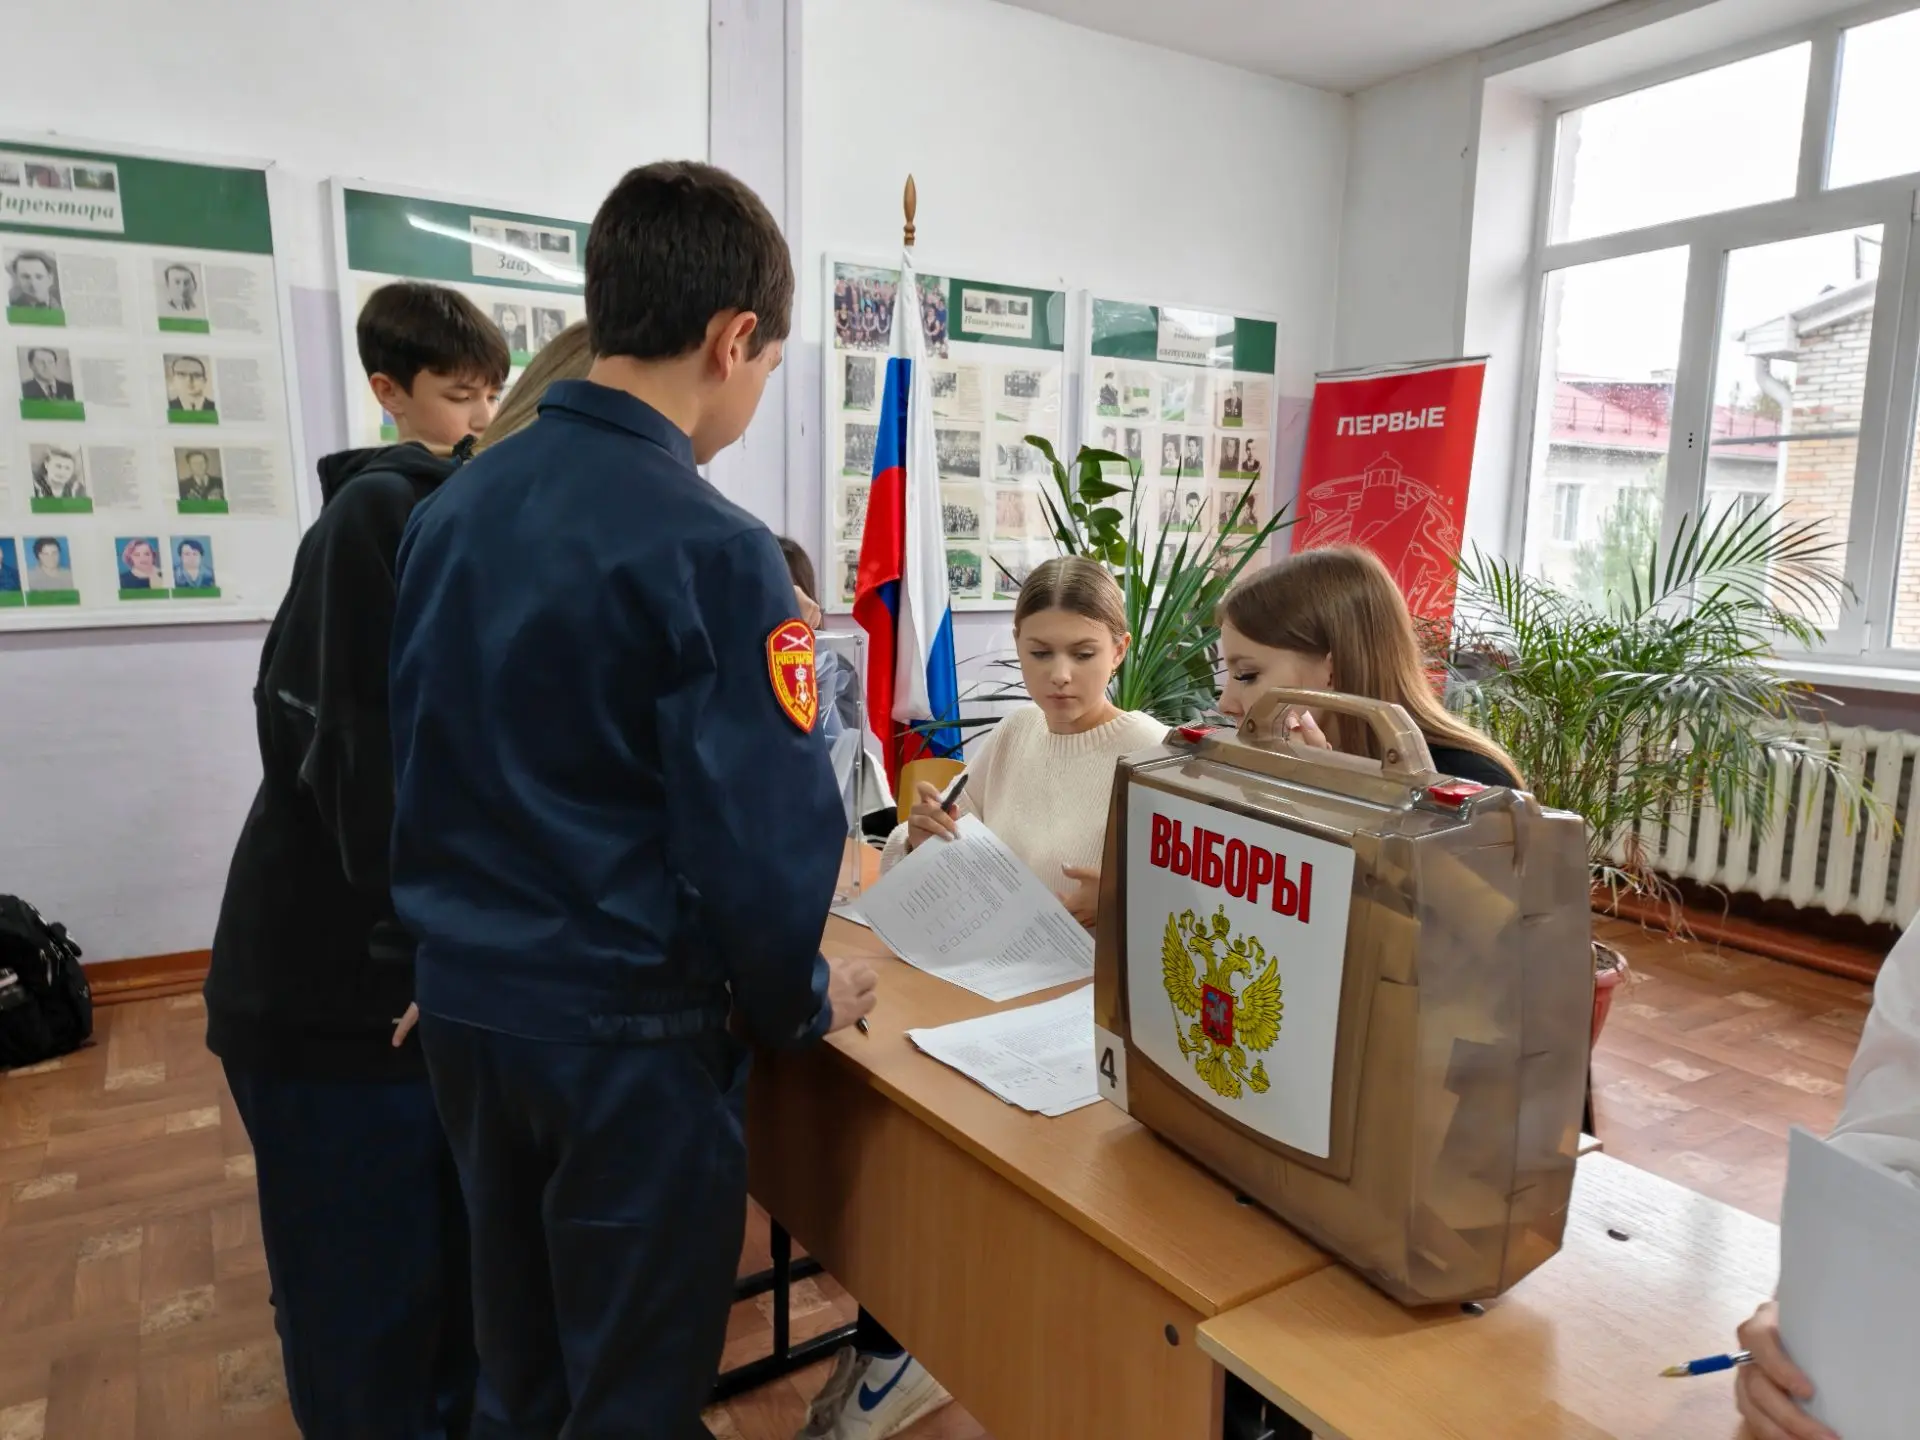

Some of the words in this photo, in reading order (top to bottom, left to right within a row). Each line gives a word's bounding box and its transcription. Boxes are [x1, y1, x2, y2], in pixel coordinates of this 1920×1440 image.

[0, 191, 115, 221] иректора
[497, 254, 538, 279] Заву
[1336, 406, 1447, 436] ПЕРВЫЕ
[1150, 812, 1313, 924] ВЫБОРЫ
[1099, 1046, 1118, 1089] 4
